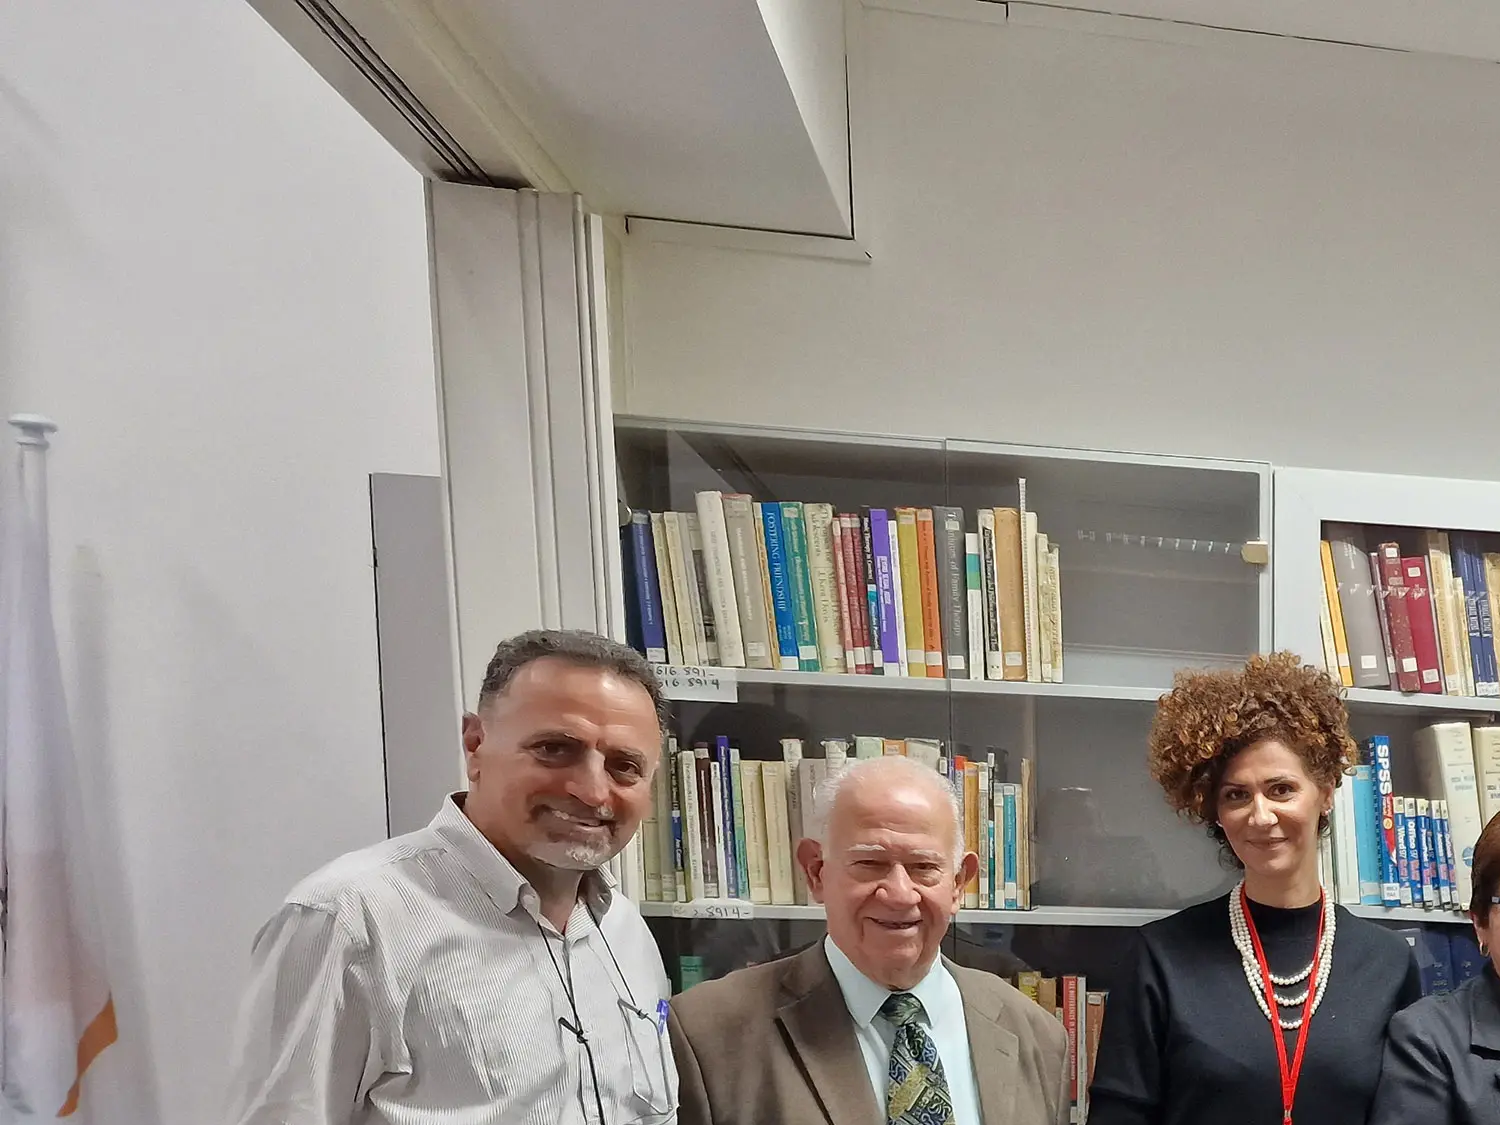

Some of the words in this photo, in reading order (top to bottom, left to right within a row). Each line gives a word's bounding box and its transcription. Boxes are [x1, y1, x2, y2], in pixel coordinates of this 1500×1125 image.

[768, 511, 780, 560] FOSTERING
[946, 511, 959, 559] Teniques
[773, 562, 785, 611] FRIENDSHIP
[950, 572, 960, 602] Family
[951, 603, 962, 638] Therapy
[1377, 744, 1391, 795] SPSS
[1396, 827, 1406, 849] Word
[1407, 820, 1417, 848] Office
